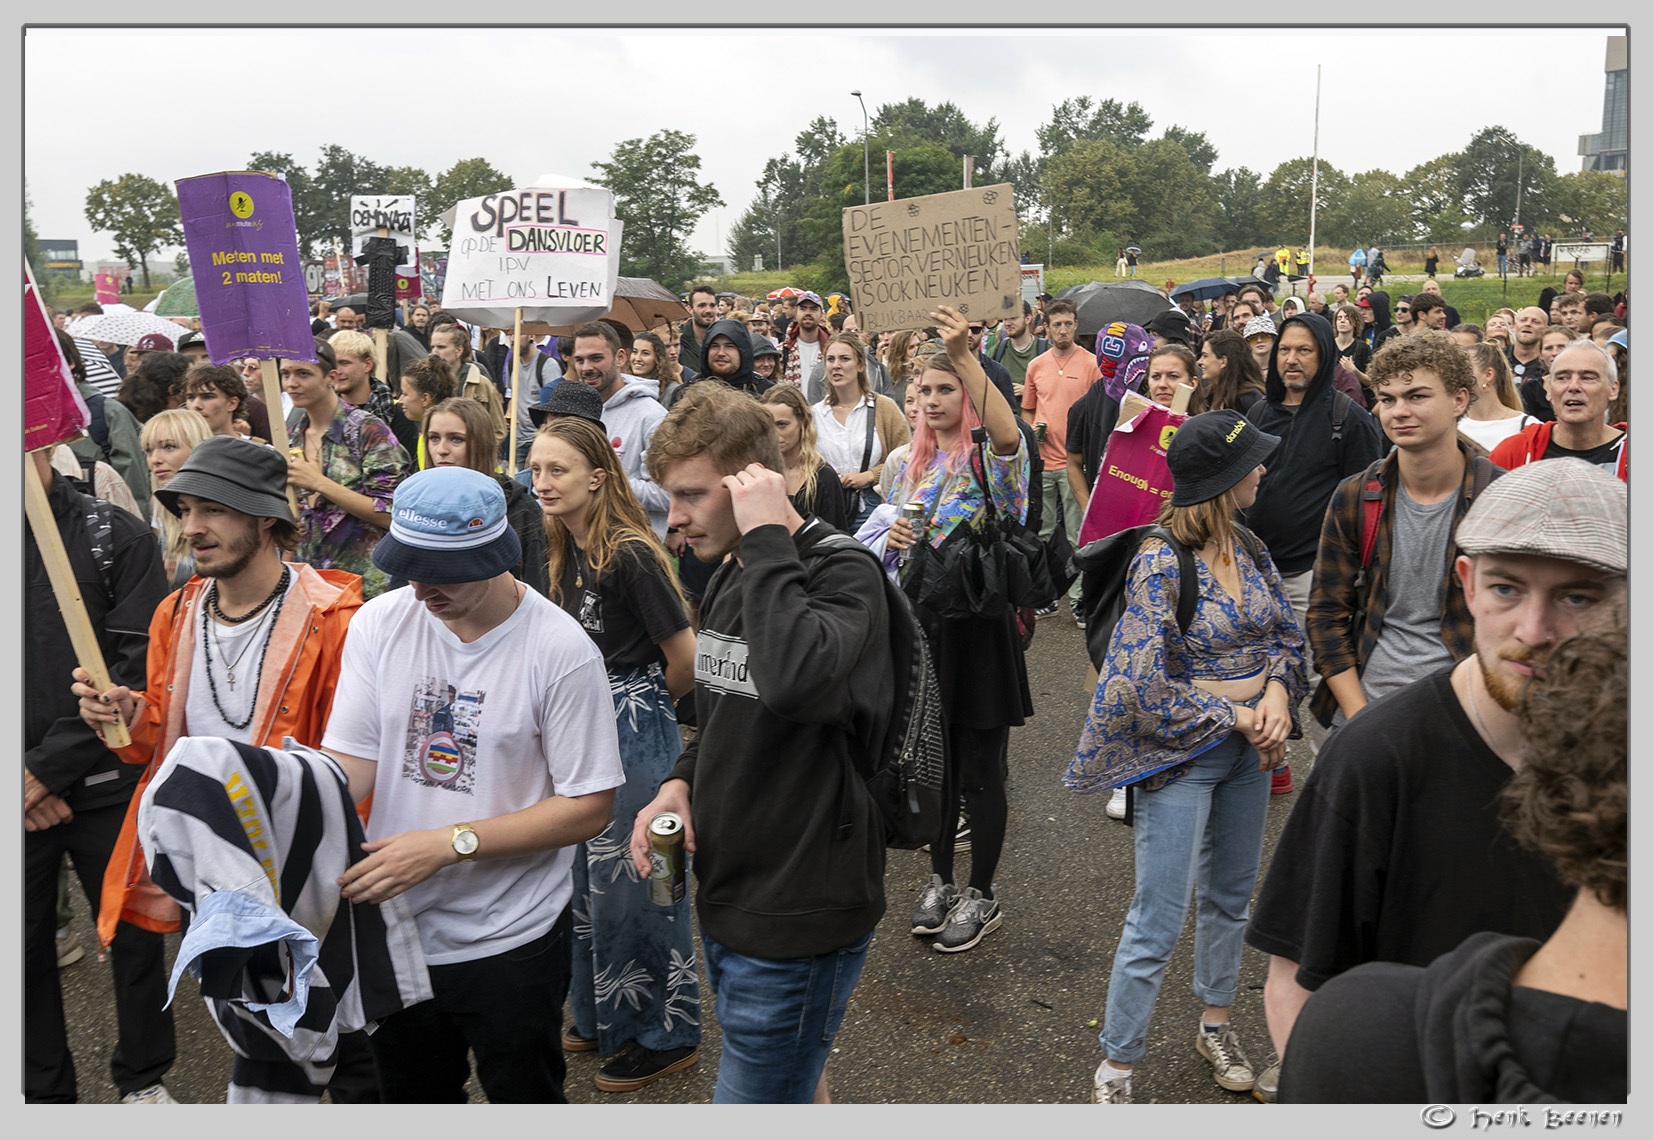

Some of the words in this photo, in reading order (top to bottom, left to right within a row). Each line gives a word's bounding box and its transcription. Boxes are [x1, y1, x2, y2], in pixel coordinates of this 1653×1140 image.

[470, 190, 580, 238] SPEEL
[851, 207, 886, 232] DE
[508, 227, 607, 254] DANSVLOER
[211, 250, 257, 266] Meten
[260, 251, 285, 265] met
[850, 255, 915, 285] SECTOR
[915, 239, 1020, 273] VERNEUKEN
[221, 271, 233, 285] 2
[235, 271, 283, 285] maten!
[462, 279, 496, 300] MET
[507, 280, 537, 299] ONS
[547, 275, 602, 298] LEVEN
[855, 283, 876, 308] IS
[876, 279, 913, 304] OOK
[915, 268, 1000, 299] NEUKEN
[398, 508, 448, 529] ellesse
